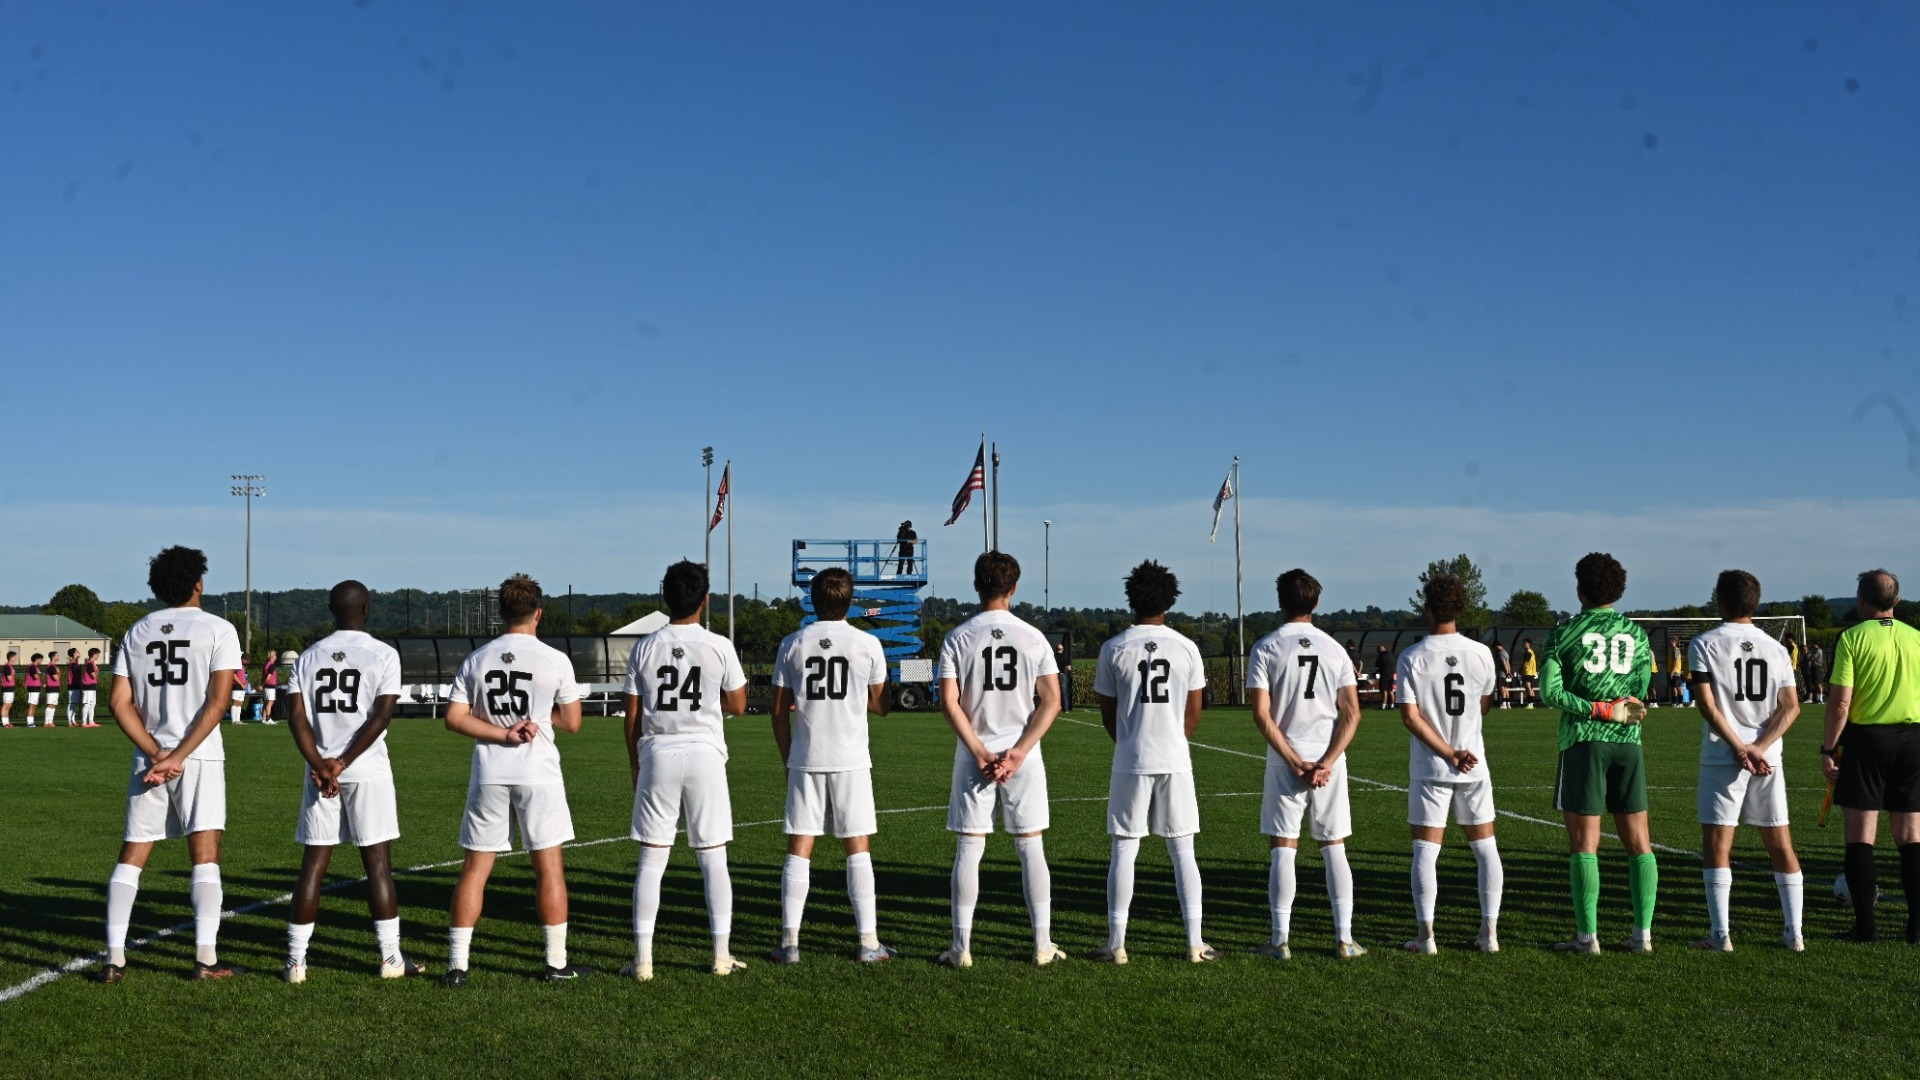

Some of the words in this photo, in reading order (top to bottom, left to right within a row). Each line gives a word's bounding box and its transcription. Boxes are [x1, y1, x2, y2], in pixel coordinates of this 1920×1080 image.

[146, 640, 190, 686] 35
[982, 646, 1017, 691] 13
[1582, 633, 1635, 674] 30
[315, 668, 361, 713] 29
[485, 670, 532, 716] 25
[657, 666, 702, 711] 24
[805, 656, 849, 700] 20
[1138, 659, 1170, 703] 12
[1298, 656, 1318, 699] 7
[1444, 673, 1464, 716] 6
[1735, 658, 1767, 701] 10
